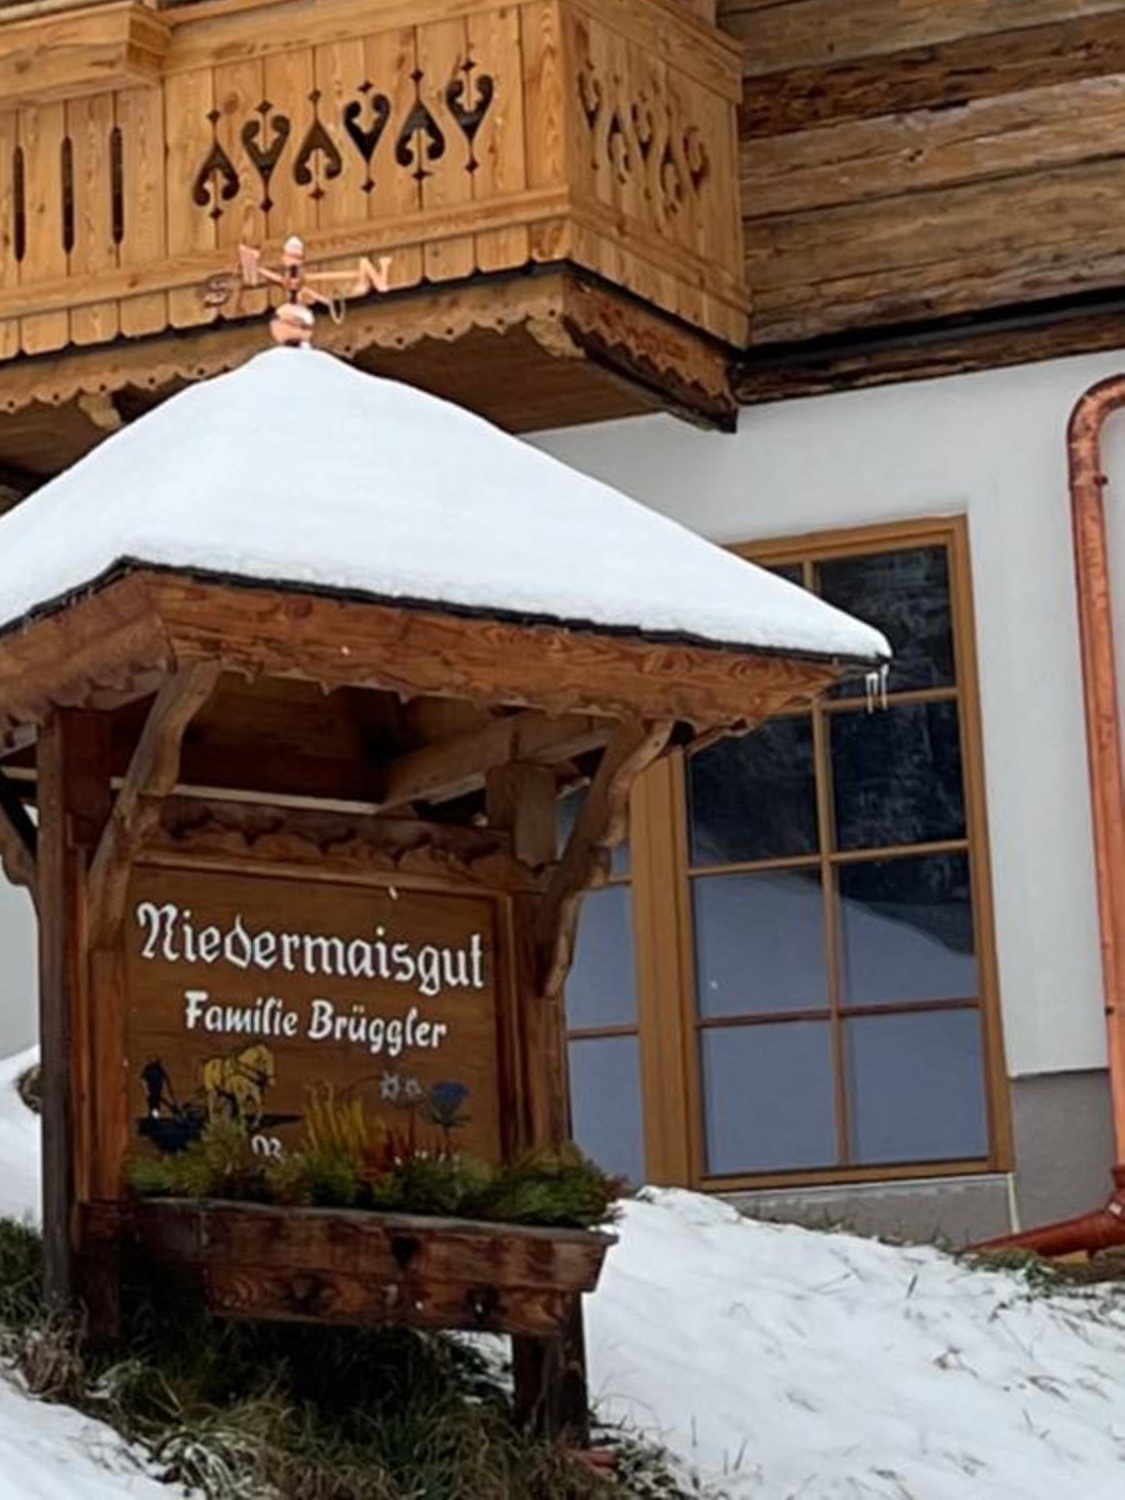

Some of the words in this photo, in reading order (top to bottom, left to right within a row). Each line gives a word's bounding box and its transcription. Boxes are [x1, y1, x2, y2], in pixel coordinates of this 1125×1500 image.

[354, 256, 392, 292] N
[137, 902, 484, 996] Niedermaisgut
[184, 990, 299, 1037] Familie
[307, 999, 447, 1057] Brüggler
